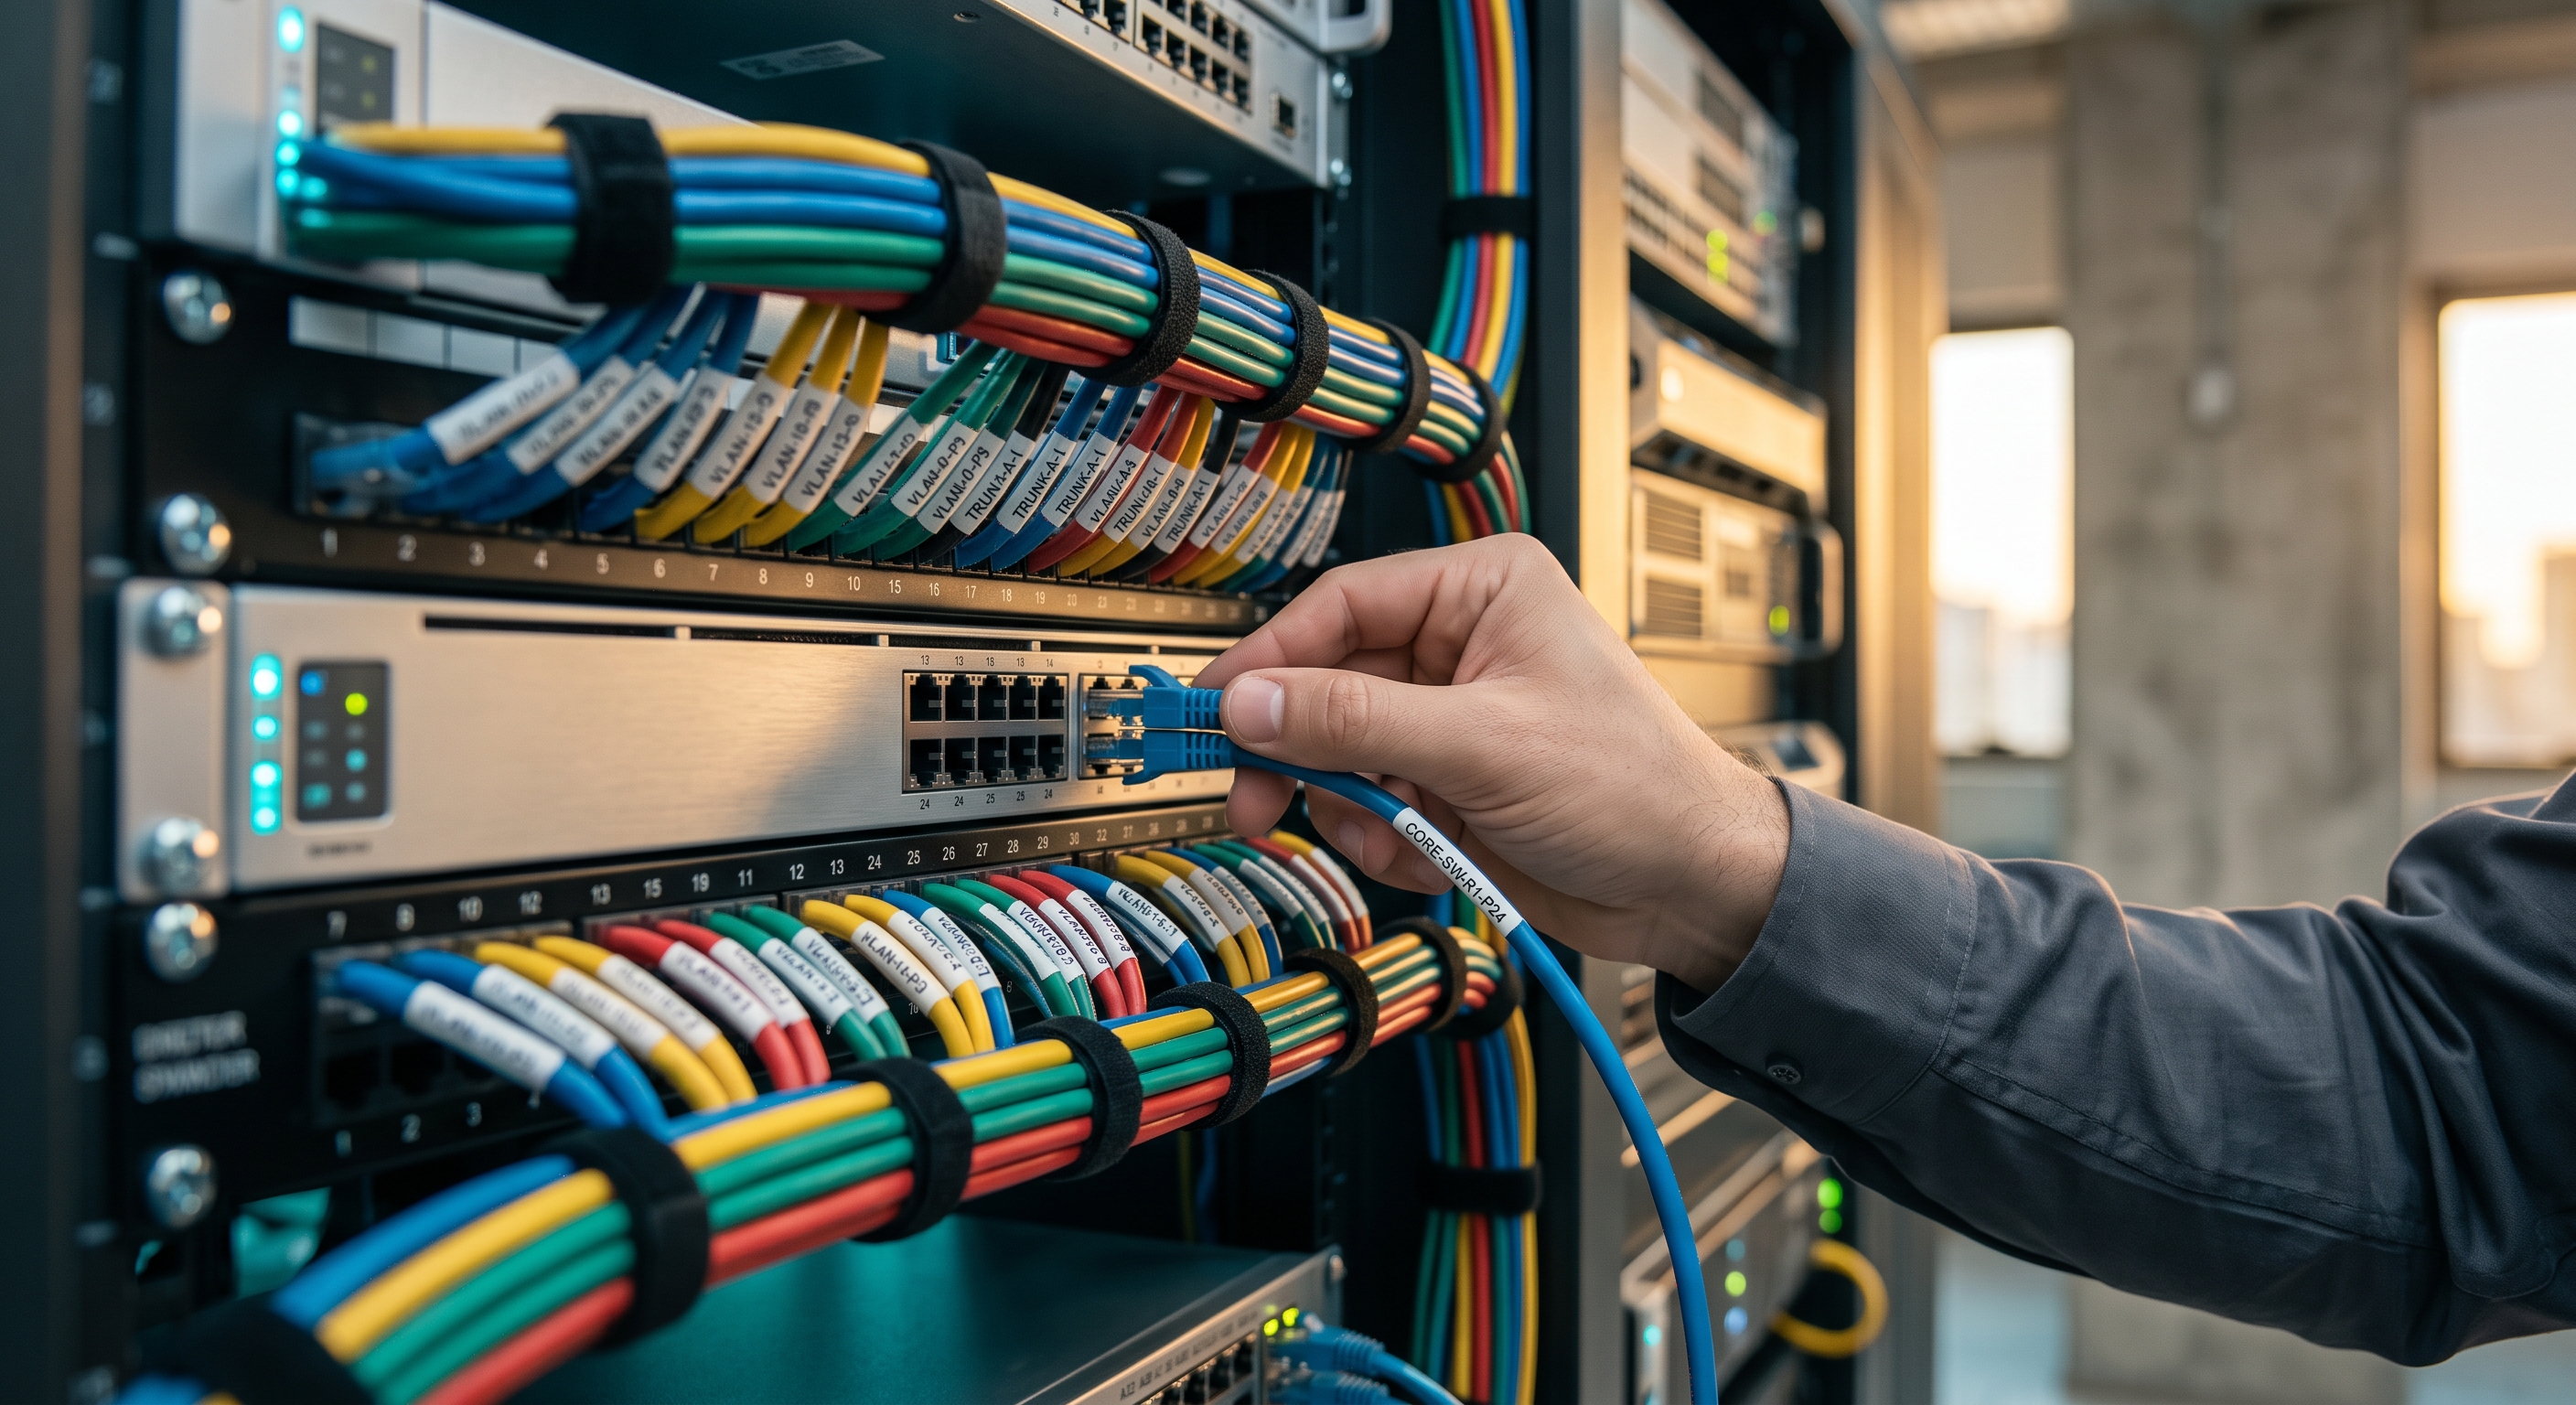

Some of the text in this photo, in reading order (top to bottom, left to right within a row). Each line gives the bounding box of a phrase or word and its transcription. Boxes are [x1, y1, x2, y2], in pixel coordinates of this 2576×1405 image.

[396, 533, 417, 563] 2
[468, 541, 486, 567] 3
[533, 549, 549, 570] 4
[596, 552, 610, 574] 5
[653, 558, 666, 578] 6
[708, 563, 719, 581] 7
[758, 567, 768, 585] 8
[805, 572, 814, 588] 9
[847, 575, 861, 591] 10
[888, 579, 902, 594] 15
[928, 583, 940, 596] 16
[965, 585, 977, 599] 17
[1001, 588, 1013, 602] 18
[1035, 591, 1046, 605] 19
[920, 654, 930, 666] 13
[954, 656, 964, 666] 13
[919, 799, 930, 810] 24
[954, 796, 964, 807] 24
[986, 793, 995, 804] 25
[1044, 788, 1053, 799] 24
[590, 883, 612, 906] 13
[643, 877, 662, 899] 15
[692, 872, 710, 893] 19
[737, 868, 753, 887] 11
[789, 863, 805, 880] 12
[830, 858, 845, 875] 13
[867, 854, 882, 871] 24
[907, 849, 921, 865] 25
[942, 846, 956, 861] 26
[975, 842, 989, 857] 27
[1007, 839, 1019, 853] 28
[1037, 835, 1049, 850] 29
[1405, 822, 1507, 923] CORE-SW-R1-P24
[400, 1112, 422, 1143] 2
[466, 1100, 483, 1128] 3
